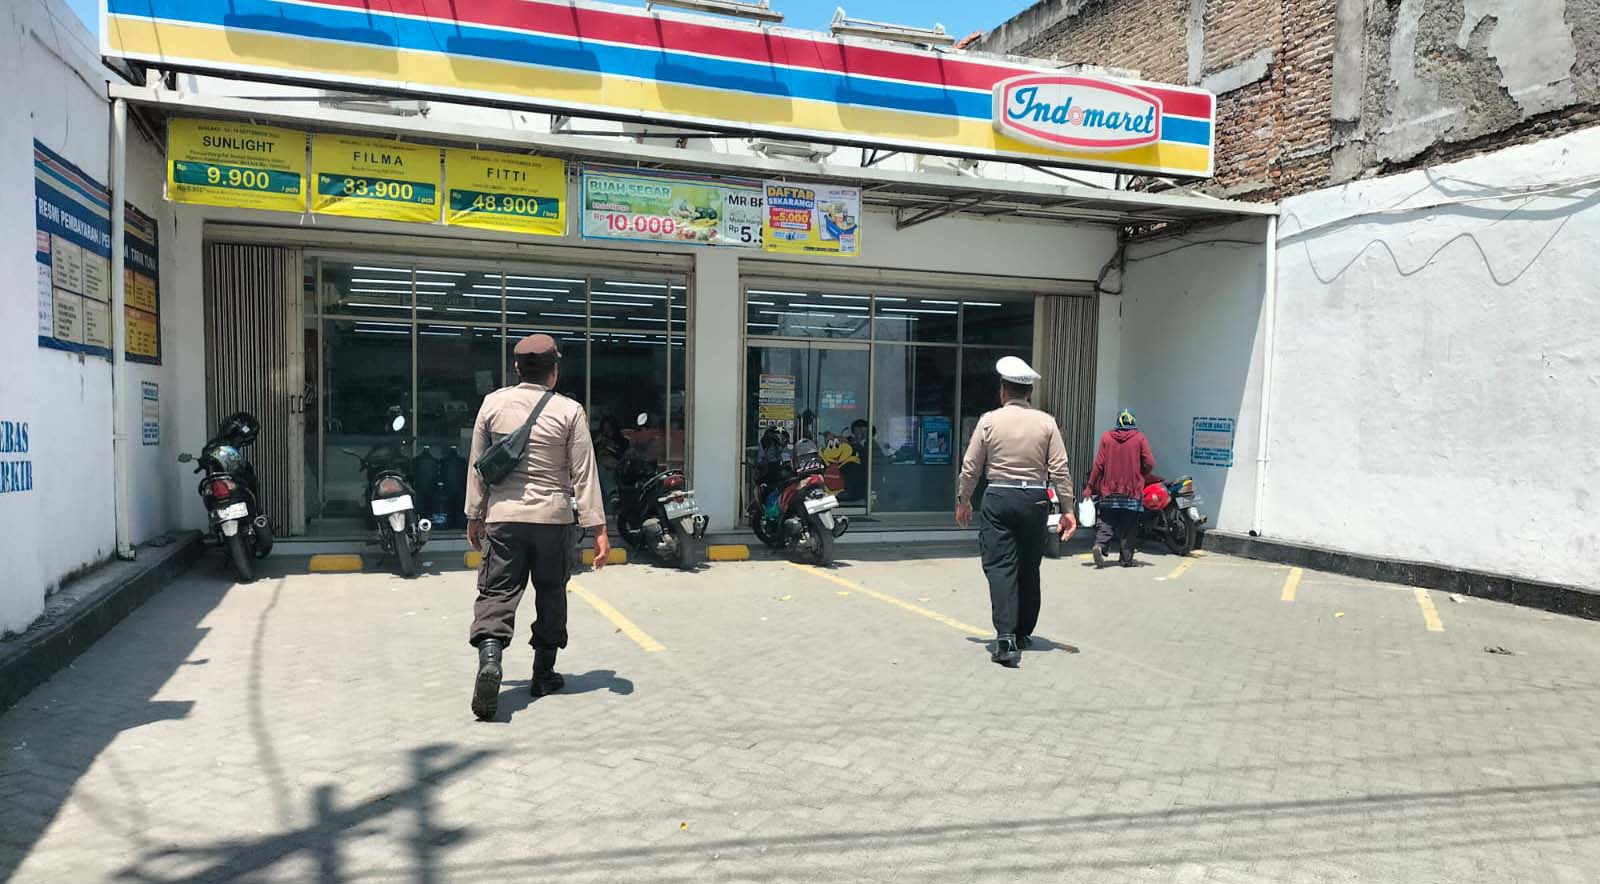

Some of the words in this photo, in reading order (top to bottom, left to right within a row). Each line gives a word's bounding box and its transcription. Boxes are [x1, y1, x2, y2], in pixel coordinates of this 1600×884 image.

[1008, 86, 1155, 134] Indomaret
[202, 135, 275, 153] SUNLIGHT
[353, 151, 403, 167] FILMA
[207, 166, 270, 189] 9.900
[487, 167, 526, 182] FITTI
[343, 178, 413, 200] 33.900
[590, 181, 625, 193] BUAH
[628, 184, 670, 197] SEGAR
[767, 186, 815, 200] DAFTAR
[472, 194, 538, 215] 48.900
[728, 194, 747, 207] MR
[768, 197, 814, 209] SEKARANG!
[39, 197, 60, 225] RESMI
[61, 209, 99, 244] PEMBAYARAN
[593, 213, 605, 221] Rp
[606, 213, 675, 235] 10.000
[728, 224, 739, 233] Rp
